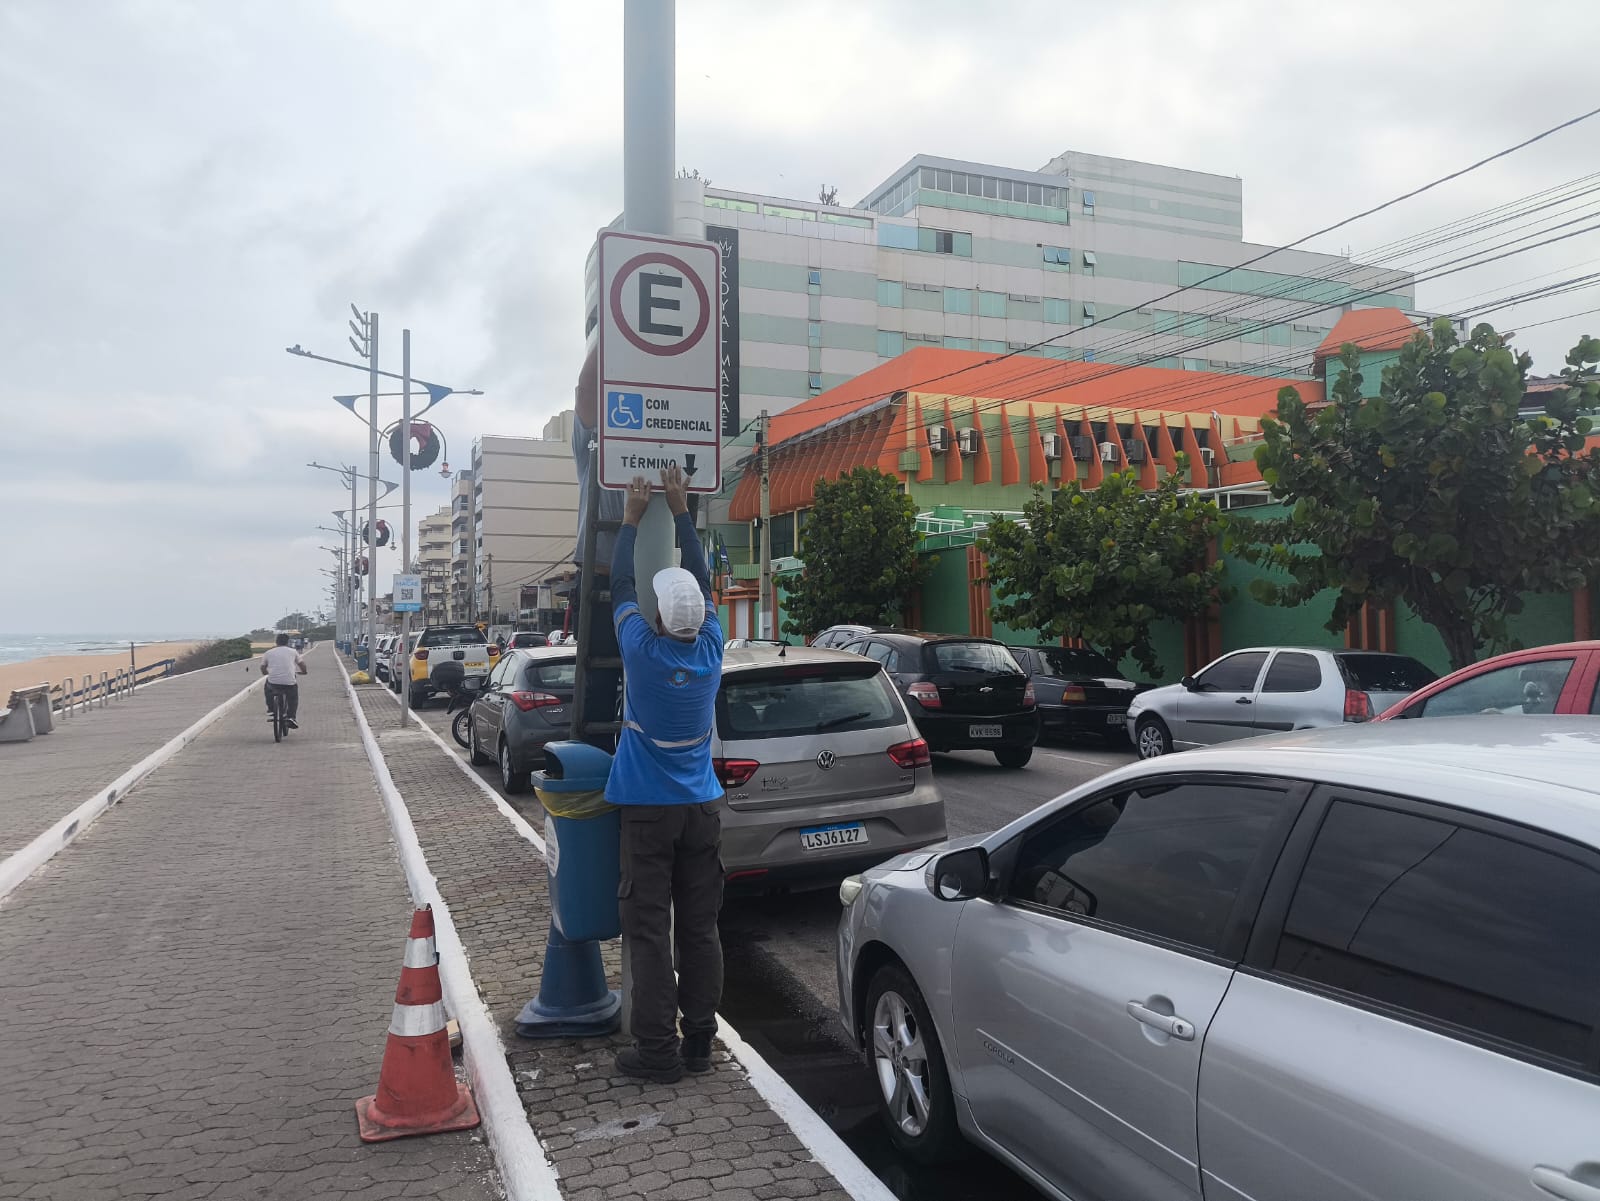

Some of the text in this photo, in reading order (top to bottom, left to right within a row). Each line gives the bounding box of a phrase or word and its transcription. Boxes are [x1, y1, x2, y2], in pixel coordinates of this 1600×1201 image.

[639, 272, 683, 337] E
[645, 398, 670, 411] COM
[645, 418, 712, 432] CREDENCIAL
[620, 454, 677, 470] TÉRMINO
